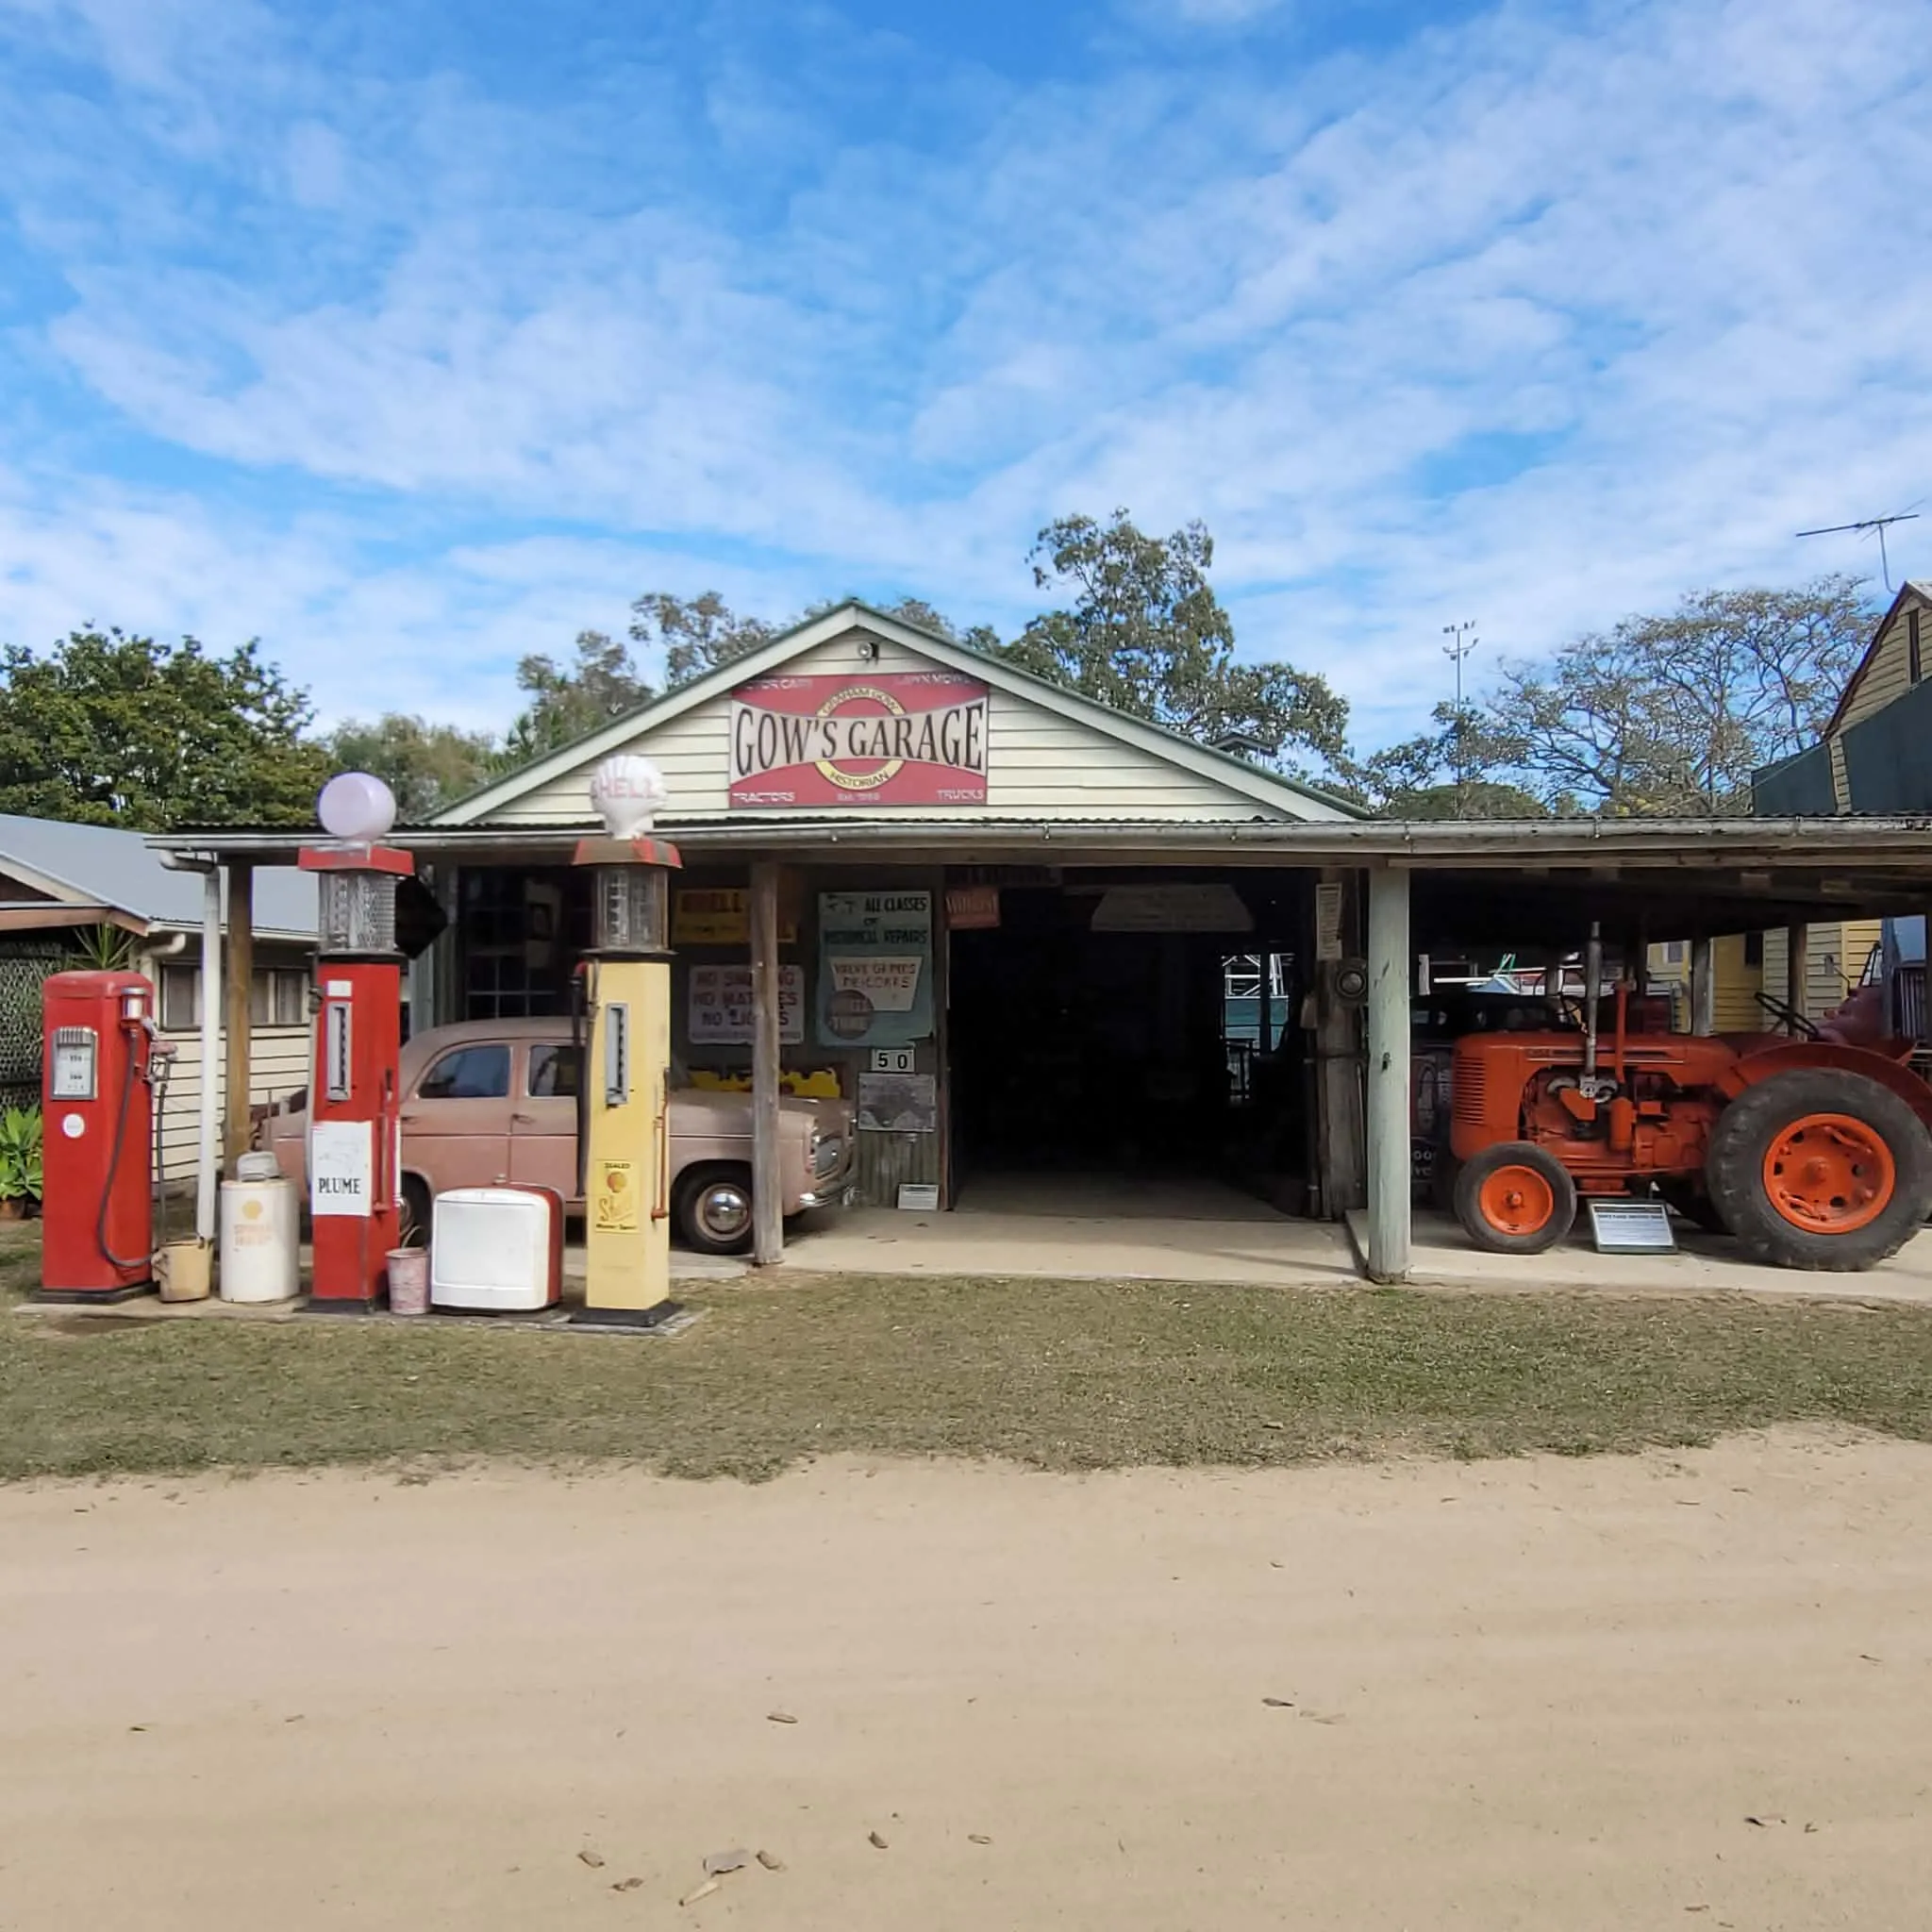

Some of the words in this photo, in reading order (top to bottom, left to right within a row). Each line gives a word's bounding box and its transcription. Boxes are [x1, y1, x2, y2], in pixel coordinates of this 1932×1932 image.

[736, 708, 838, 776] GOW'S
[848, 703, 985, 770] GARAGE
[829, 770, 891, 788] HISTORIAN
[732, 791, 796, 803] TRACTORS
[936, 789, 984, 800] TRUCKS
[865, 897, 881, 912] ALL
[884, 897, 928, 911] CLASSES
[884, 929, 928, 944] REPAIRS
[723, 991, 798, 1007] MATES
[701, 1011, 723, 1026] NO
[729, 1010, 791, 1026] LIGS
[317, 1177, 361, 1194] PLUME
